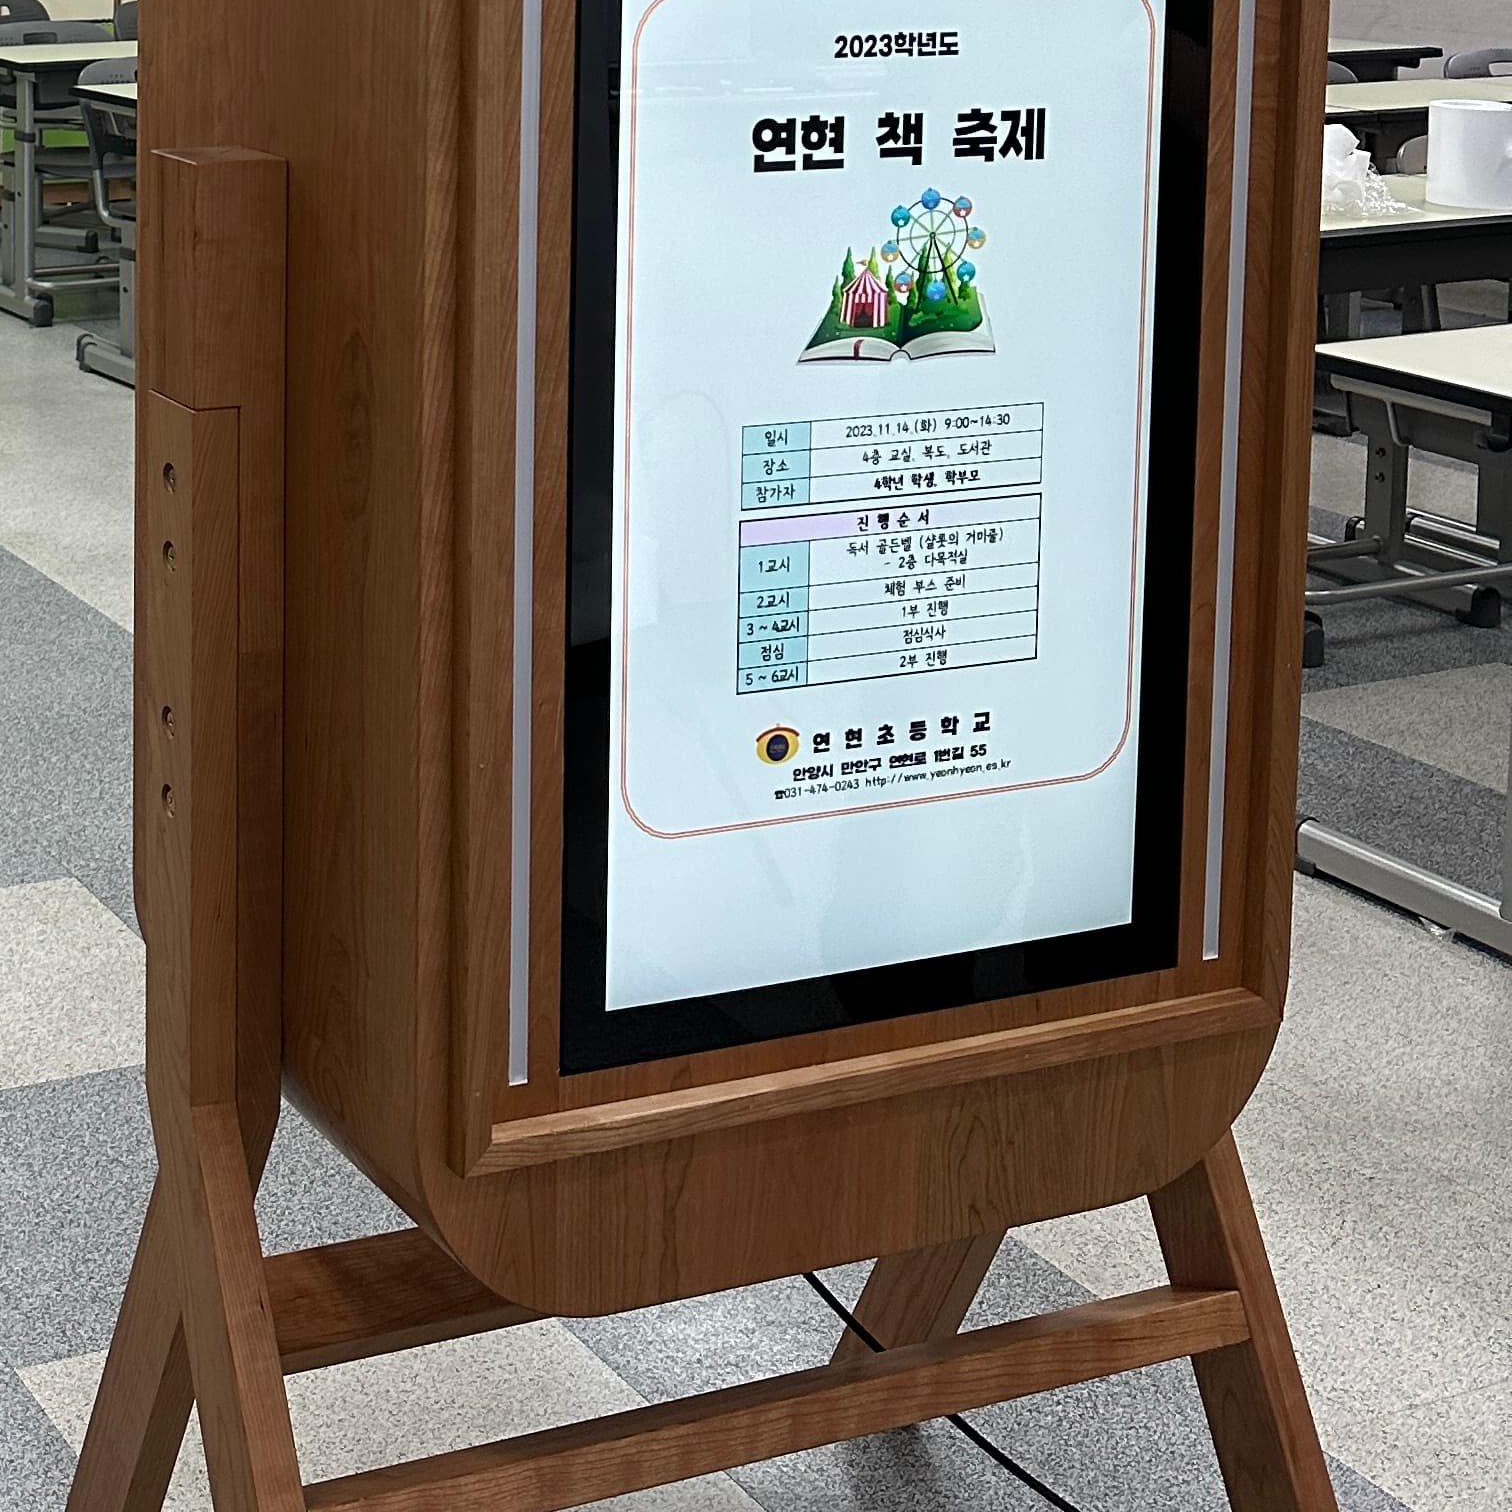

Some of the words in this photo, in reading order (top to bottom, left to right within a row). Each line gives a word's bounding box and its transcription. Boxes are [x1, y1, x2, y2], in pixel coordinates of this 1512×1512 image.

[834, 31, 959, 59] 2023학년도
[752, 115, 845, 173] 연현
[875, 112, 924, 166] 책
[952, 107, 1047, 163] 축제
[764, 428, 789, 448] 일시
[956, 439, 993, 456] 도서관
[762, 457, 790, 476] 장소
[874, 474, 904, 491] 4학년
[945, 469, 982, 486] 학부모
[846, 540, 869, 557] 독서
[876, 536, 913, 555] 골든벨
[758, 555, 791, 574] 1교시
[898, 554, 918, 570] 2층
[924, 549, 969, 567] 다목적실
[884, 579, 907, 597] 체험
[913, 579, 938, 594] 부스
[944, 573, 966, 591] 준비
[756, 591, 790, 609] 2교시
[901, 604, 921, 619] 1부
[926, 599, 949, 618] 진행
[746, 623, 754, 636] 3
[771, 616, 800, 633] 4교시
[903, 624, 947, 644] 점심식사
[760, 642, 785, 662] 점심
[899, 654, 919, 668] 2부
[925, 648, 948, 667] 진행
[745, 672, 754, 686] 5
[771, 666, 799, 683] 6교시
[792, 763, 834, 782] 안양시
[840, 757, 882, 776] 만안구
[888, 751, 927, 769] 연현로
[933, 745, 965, 763] 1번길
[970, 743, 988, 758] 55
